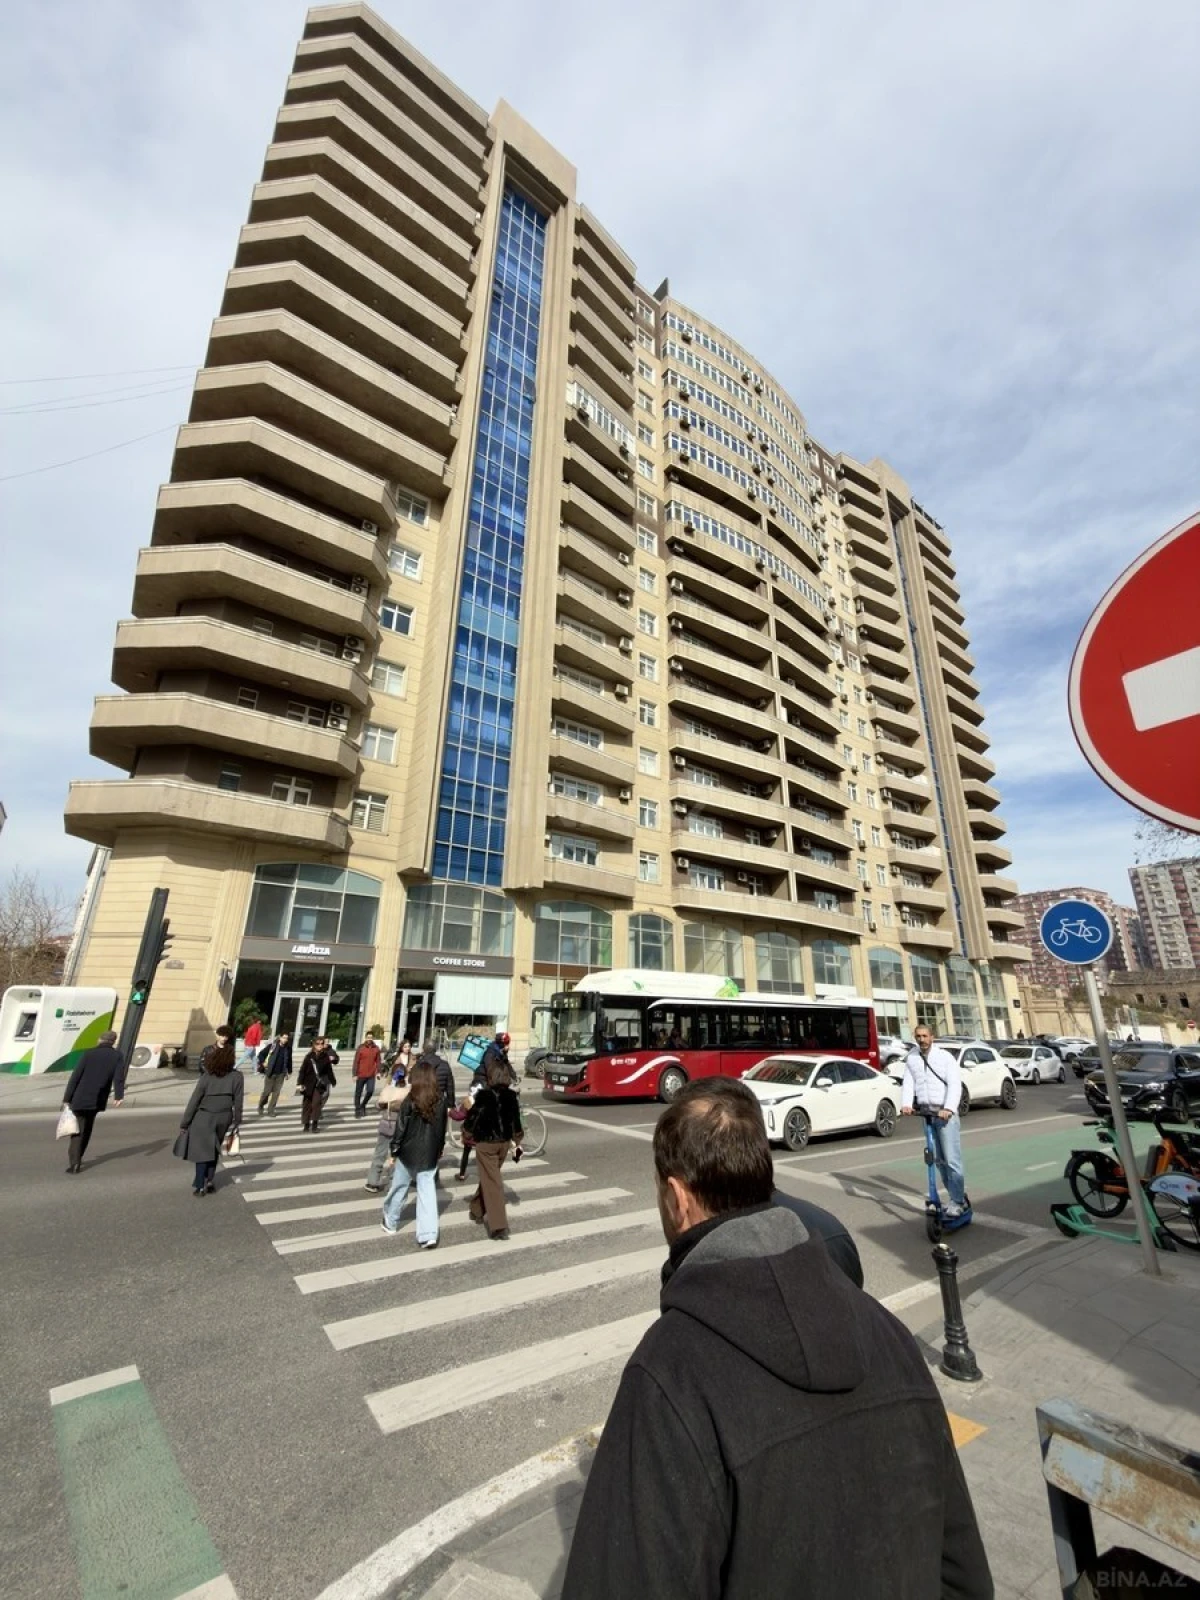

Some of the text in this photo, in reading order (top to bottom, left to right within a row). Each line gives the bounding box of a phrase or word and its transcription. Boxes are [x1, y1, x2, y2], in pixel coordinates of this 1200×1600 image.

[291, 943, 331, 956] LAVAZZA
[433, 957, 486, 968] COFFEE STORE
